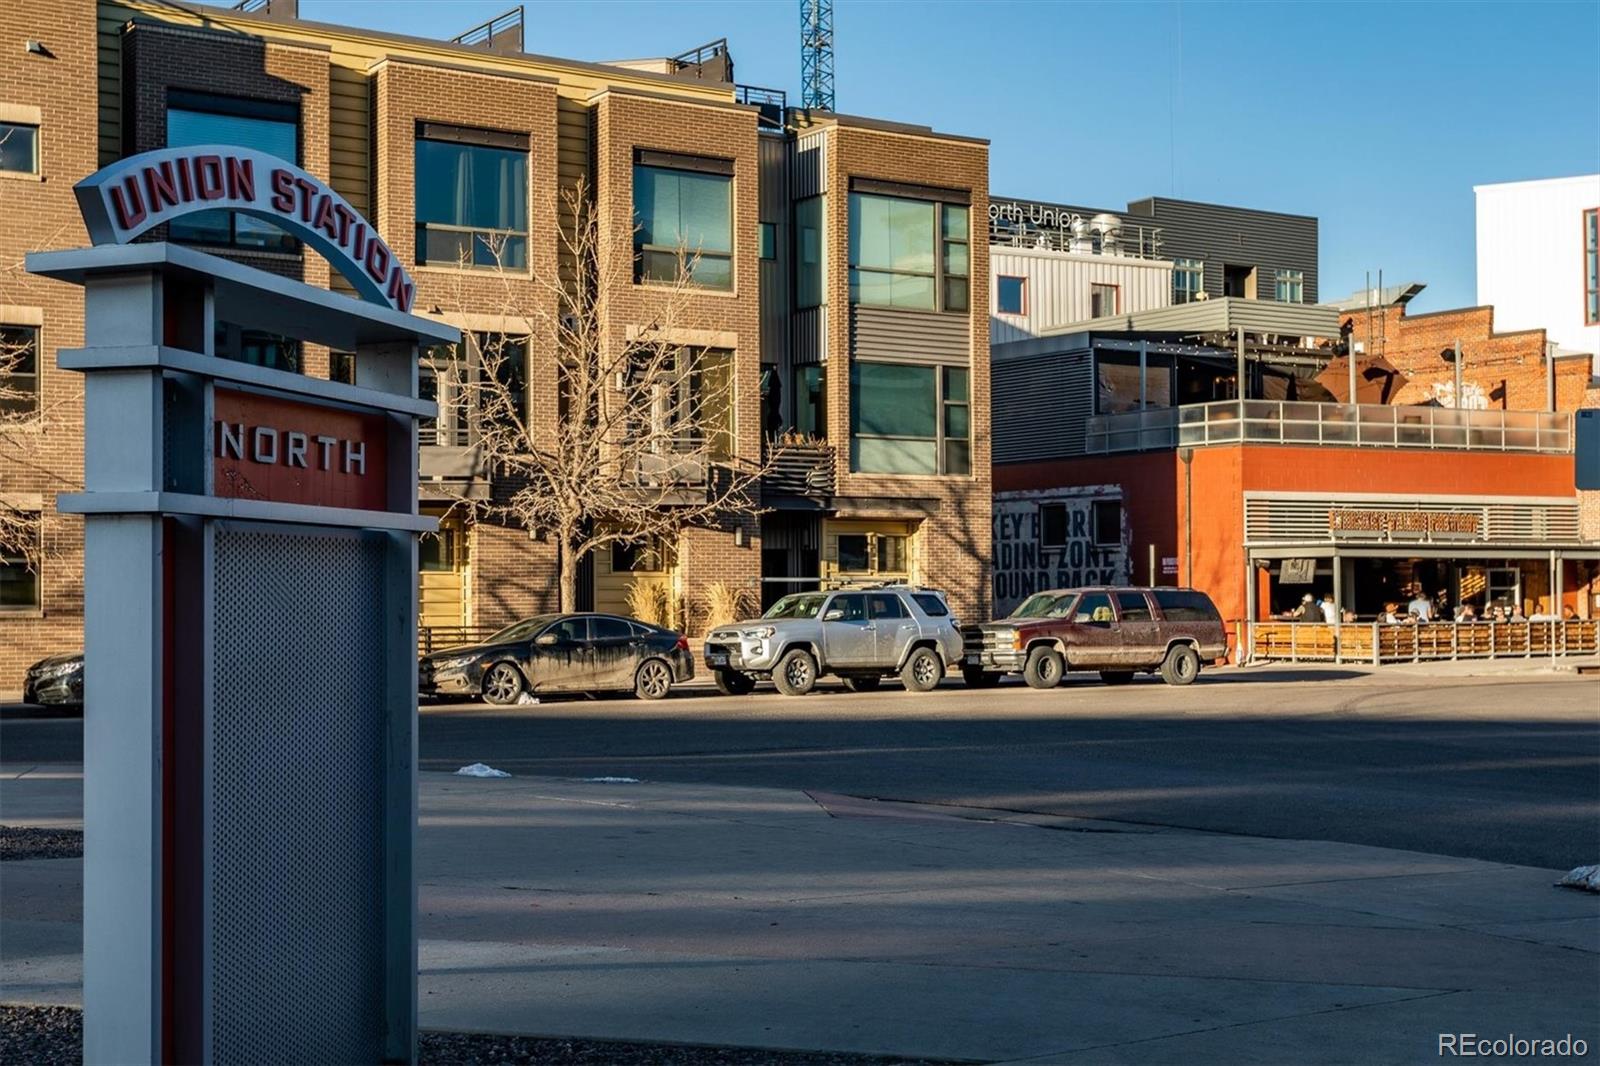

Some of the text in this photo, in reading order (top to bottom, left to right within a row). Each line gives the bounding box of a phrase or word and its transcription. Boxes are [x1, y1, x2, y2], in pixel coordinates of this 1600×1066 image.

[1030, 204, 1081, 228] Union
[110, 154, 412, 313] UNION STATION
[218, 420, 366, 475] NORTH
[1058, 541, 1115, 569] ZONE
[992, 571, 1050, 599] OUND
